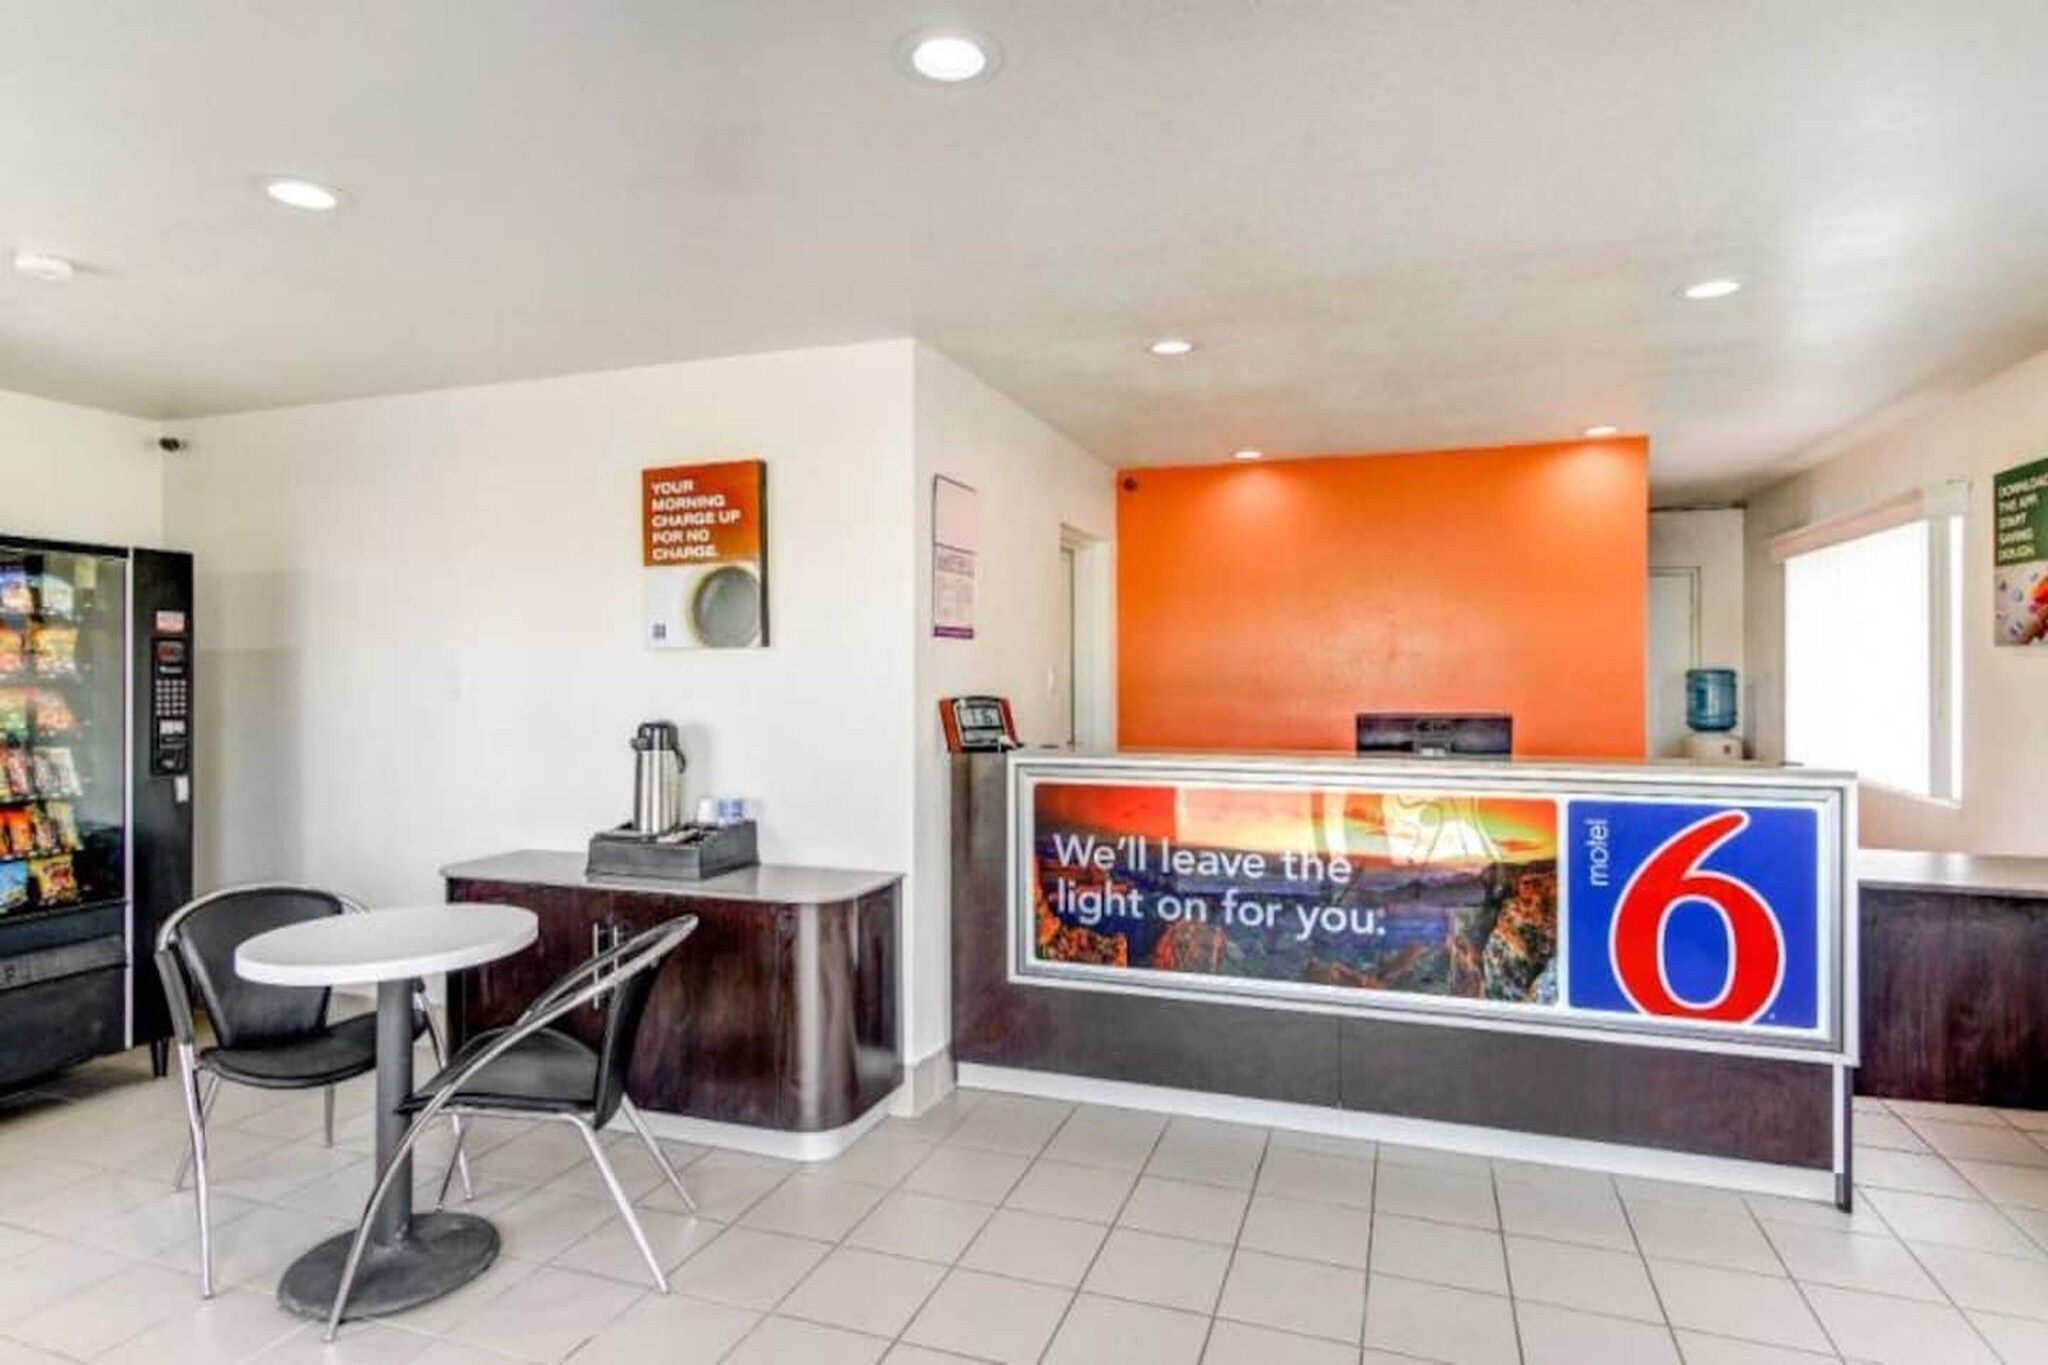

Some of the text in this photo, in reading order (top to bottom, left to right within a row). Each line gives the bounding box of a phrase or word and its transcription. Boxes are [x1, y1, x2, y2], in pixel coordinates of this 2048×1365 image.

[652, 479, 694, 495] YOUR
[652, 494, 725, 512] MORNING
[652, 508, 741, 528] CHARGE UP
[652, 526, 710, 545] FOR NO
[652, 544, 719, 560] CHARGE.
[1053, 832, 1353, 884] We'll leave the
[1585, 818, 1609, 887] motel
[1057, 876, 1144, 926] light
[1157, 895, 1208, 922] on
[1221, 888, 1282, 928] for
[1608, 809, 1787, 1024] 6
